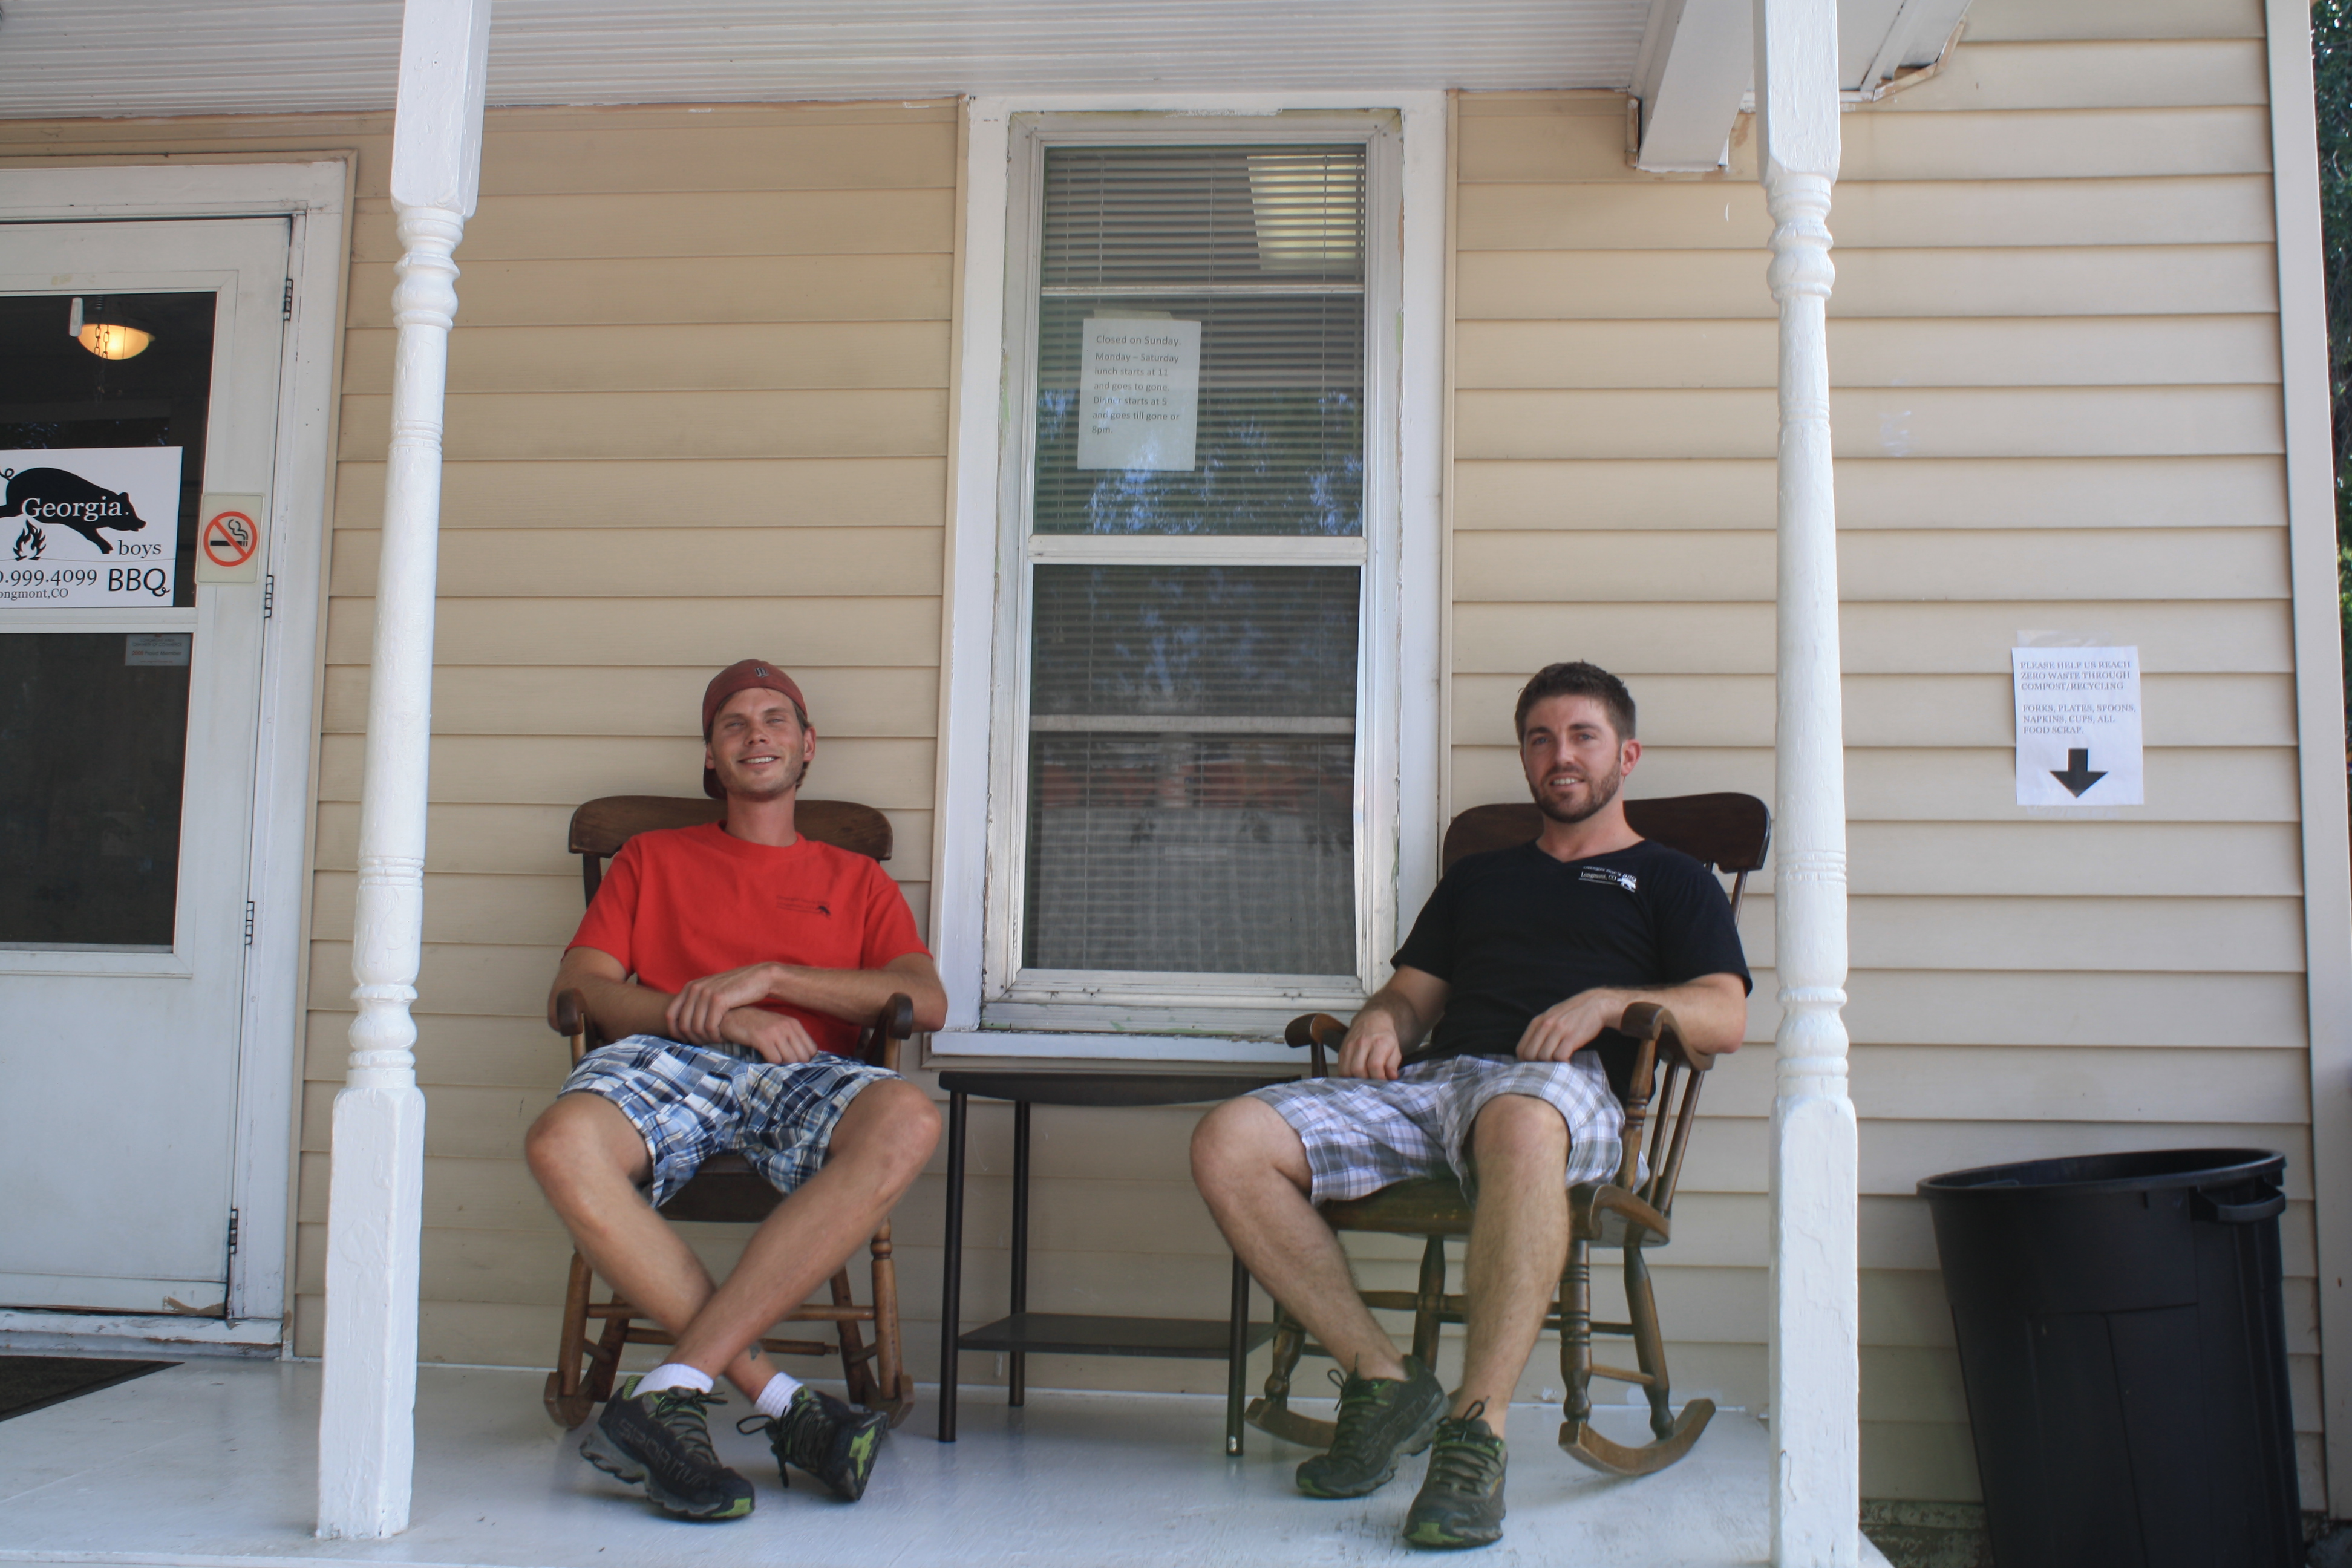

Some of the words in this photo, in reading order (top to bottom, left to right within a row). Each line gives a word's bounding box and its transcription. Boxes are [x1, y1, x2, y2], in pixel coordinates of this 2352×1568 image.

[1096, 335, 1127, 344] Closed
[1145, 336, 1181, 347] Sunday.
[1096, 353, 1131, 362] Monday
[1141, 353, 1179, 364] Saturday
[1094, 367, 1117, 375] lunch
[1146, 413, 1168, 422] gone
[1091, 426, 1113, 435] 8pm.
[22, 496, 122, 521] Georgia
[118, 540, 162, 558] boys
[108, 567, 171, 597] BBQ
[2099, 661, 2131, 669] REACH
[2048, 671, 2080, 680] WASTE
[2082, 671, 2130, 679] THROUGH
[2021, 682, 2124, 691] COMPOST/RECYCLING
[2023, 704, 2056, 713] FORKS,
[2058, 704, 2095, 713] PLATES,
[2096, 704, 2136, 713] SPOONS,
[2023, 715, 2067, 724] NAPKINS,
[2069, 714, 2095, 724] CUPS,
[2097, 714, 2115, 724] ALL
[2024, 726, 2050, 734] FOOD
[2051, 726, 2084, 734] SCRAP.
